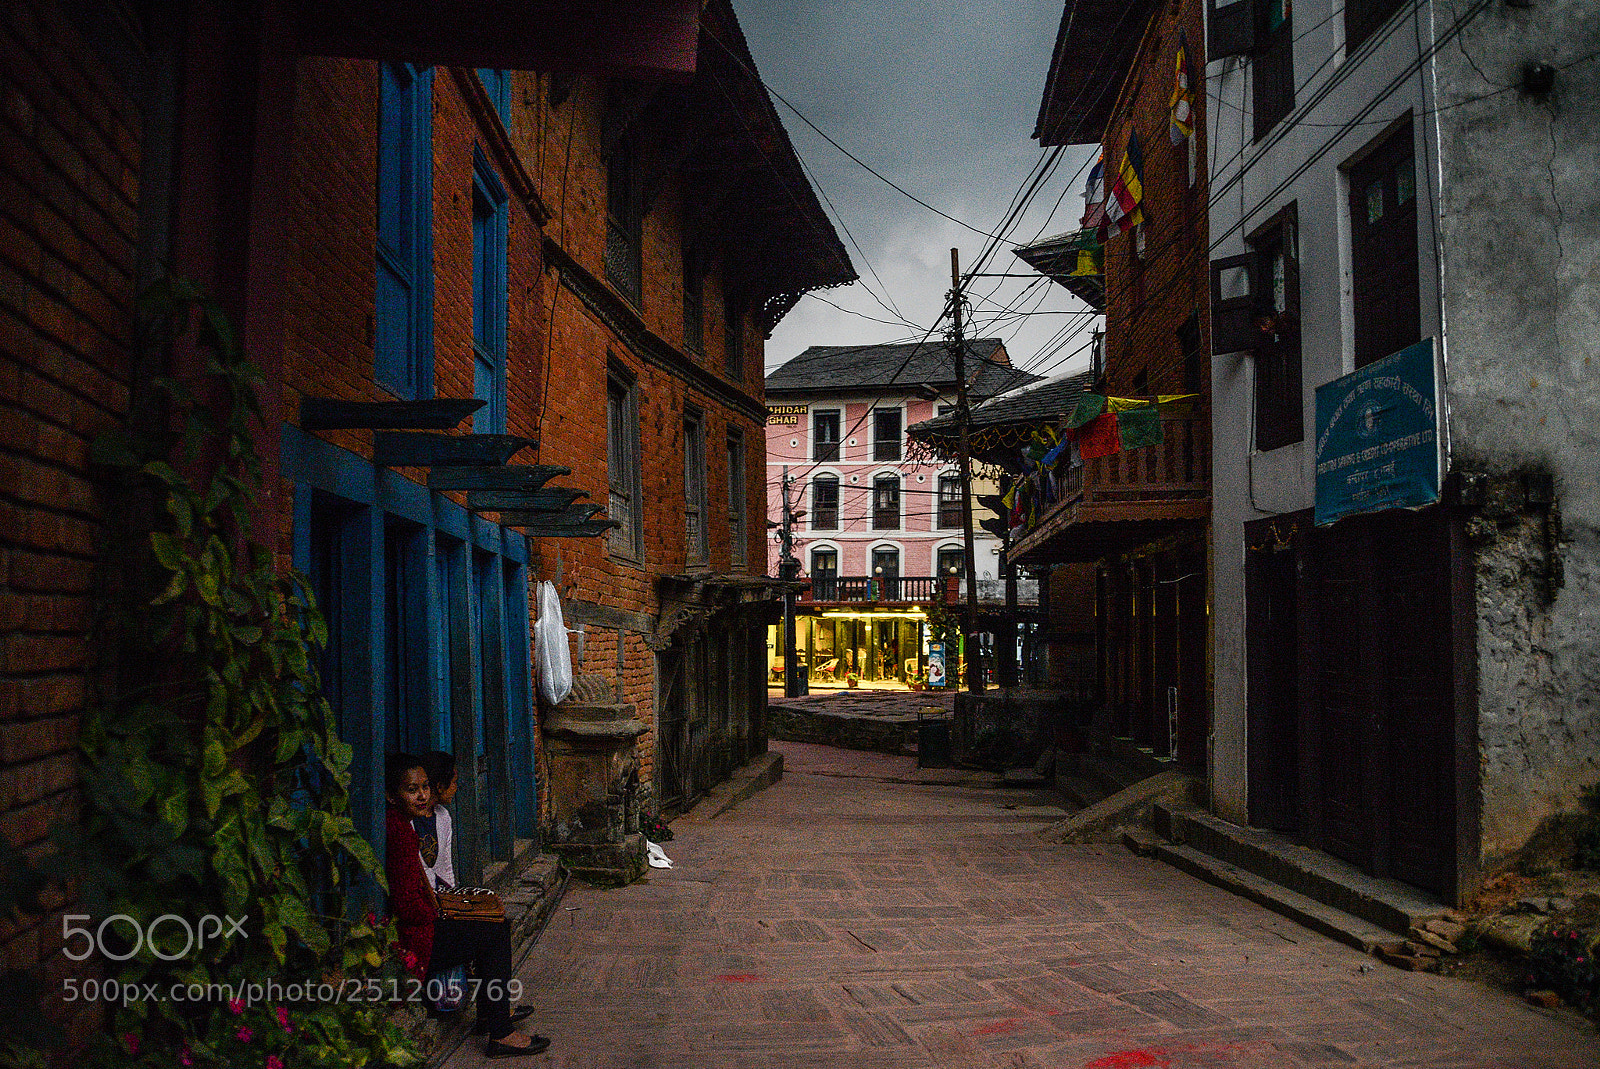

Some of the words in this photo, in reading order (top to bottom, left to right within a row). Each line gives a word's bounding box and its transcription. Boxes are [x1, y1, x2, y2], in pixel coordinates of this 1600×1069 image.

[765, 406, 807, 414] AHIDAR
[769, 416, 797, 424] GHAR
[1361, 445, 1380, 462] CREDIT
